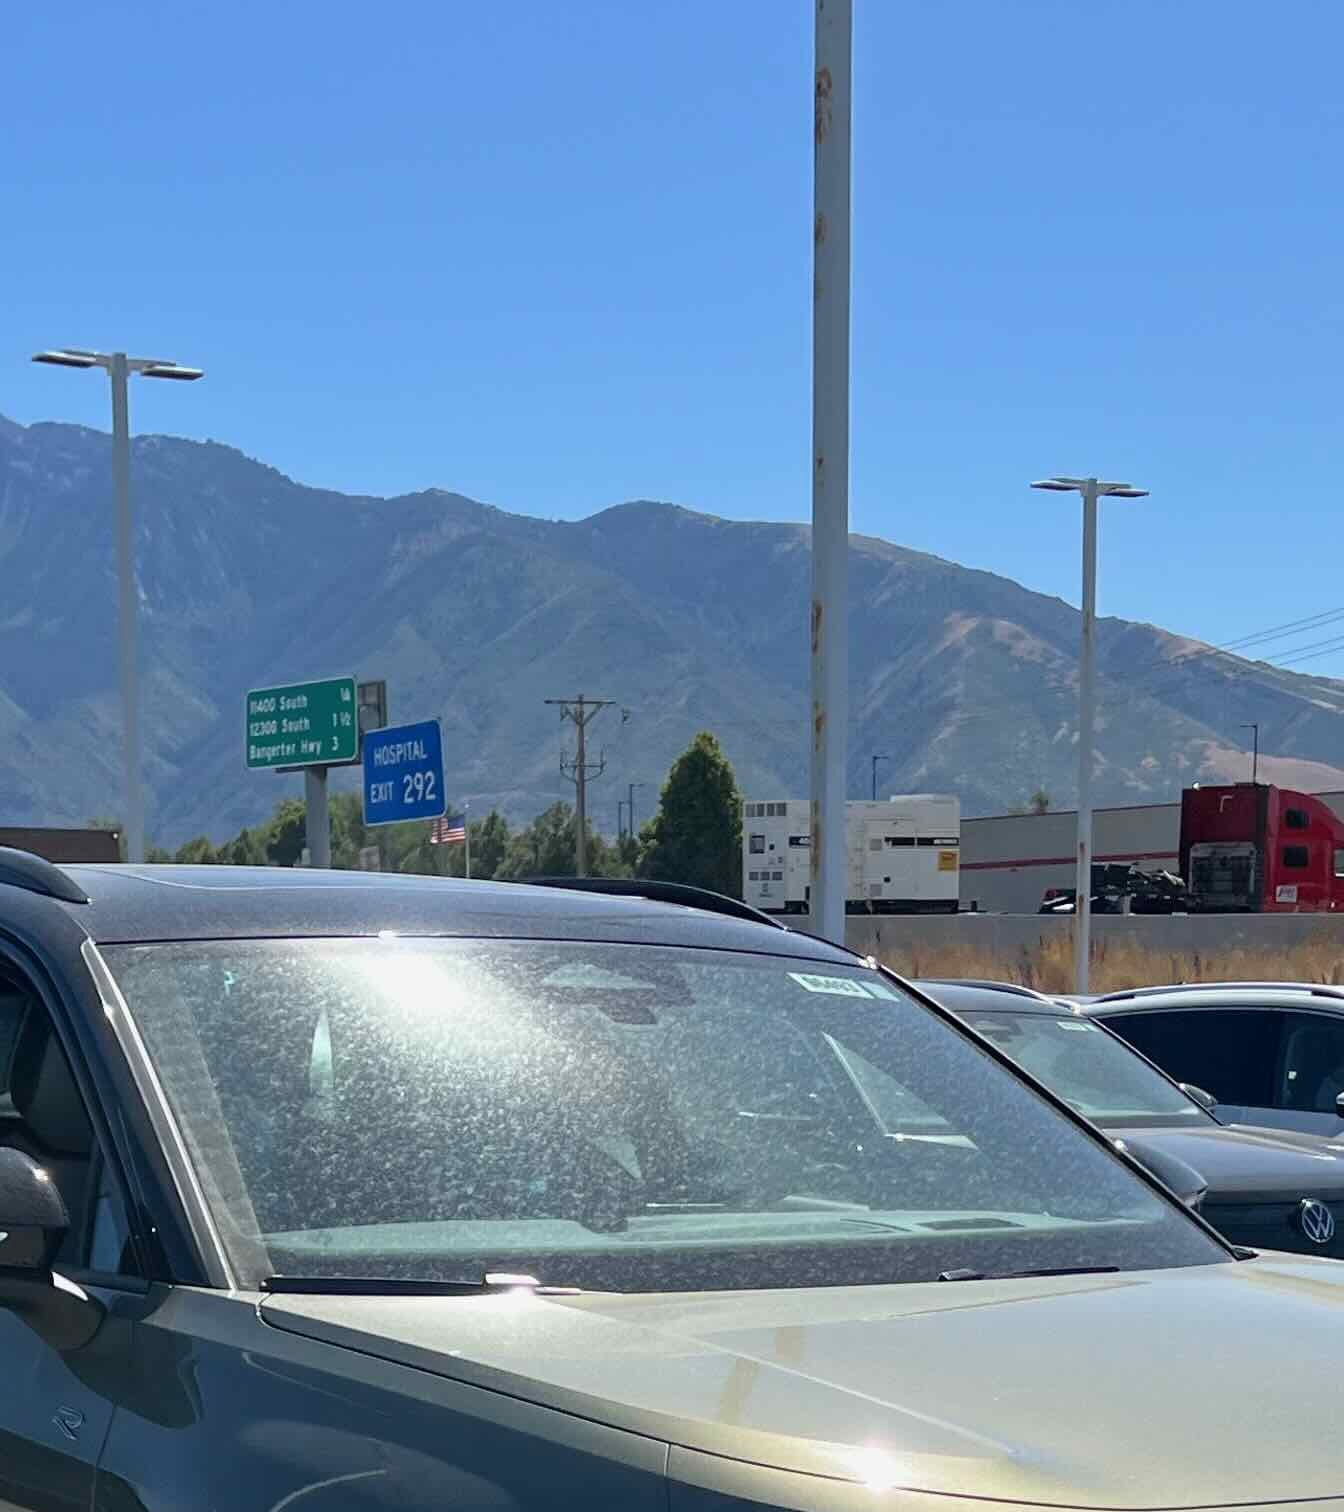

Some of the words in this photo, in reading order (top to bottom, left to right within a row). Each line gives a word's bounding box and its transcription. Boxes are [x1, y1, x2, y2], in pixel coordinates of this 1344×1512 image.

[249, 697, 276, 715] 11400
[279, 694, 308, 711] South
[249, 719, 278, 737] 12300
[281, 717, 310, 733] South
[249, 742, 296, 762] Bangerter
[300, 739, 322, 757] Hwy
[332, 736, 339, 751] 3
[373, 740, 428, 768] HOSPITAL
[370, 781, 394, 804] EXIT
[403, 770, 436, 804] 292
